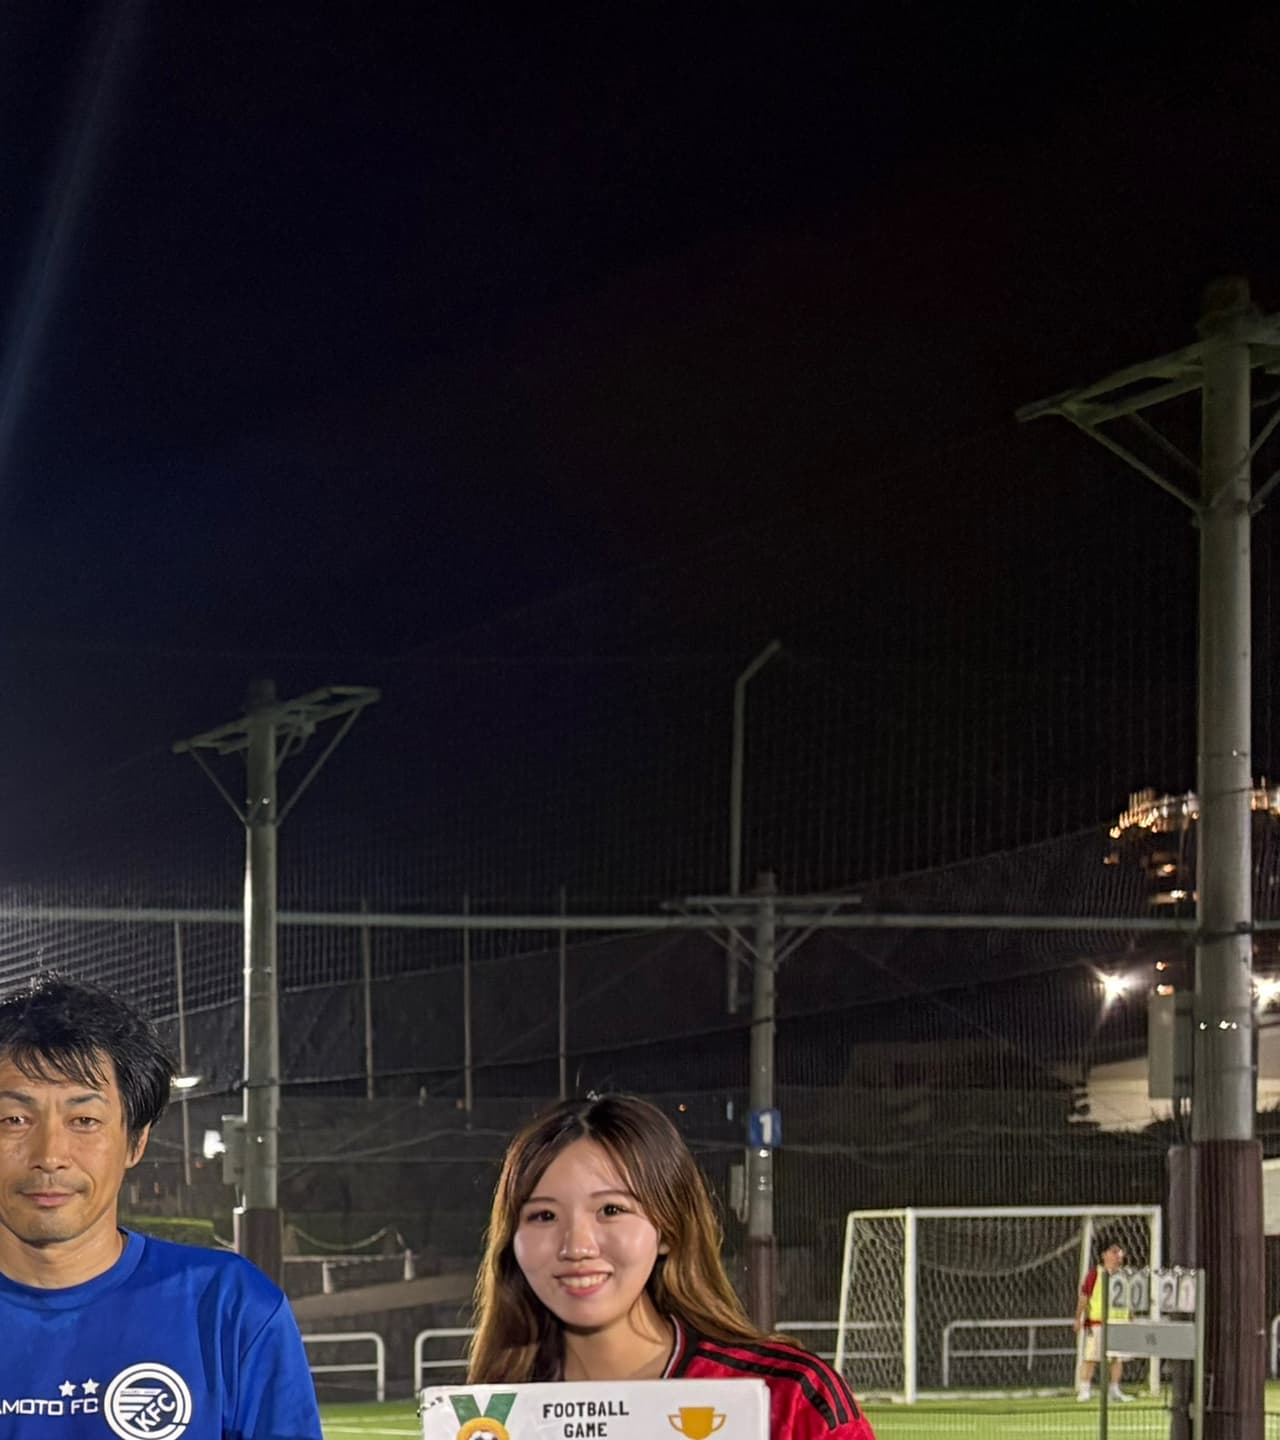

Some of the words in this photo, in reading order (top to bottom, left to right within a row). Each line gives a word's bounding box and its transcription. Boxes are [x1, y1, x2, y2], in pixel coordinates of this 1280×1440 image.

[759, 1111, 772, 1144] 1
[71, 1397, 99, 1415] FC
[133, 1393, 176, 1433] KFC
[542, 1400, 630, 1419] FOOTBALL
[563, 1421, 608, 1439] GAME
